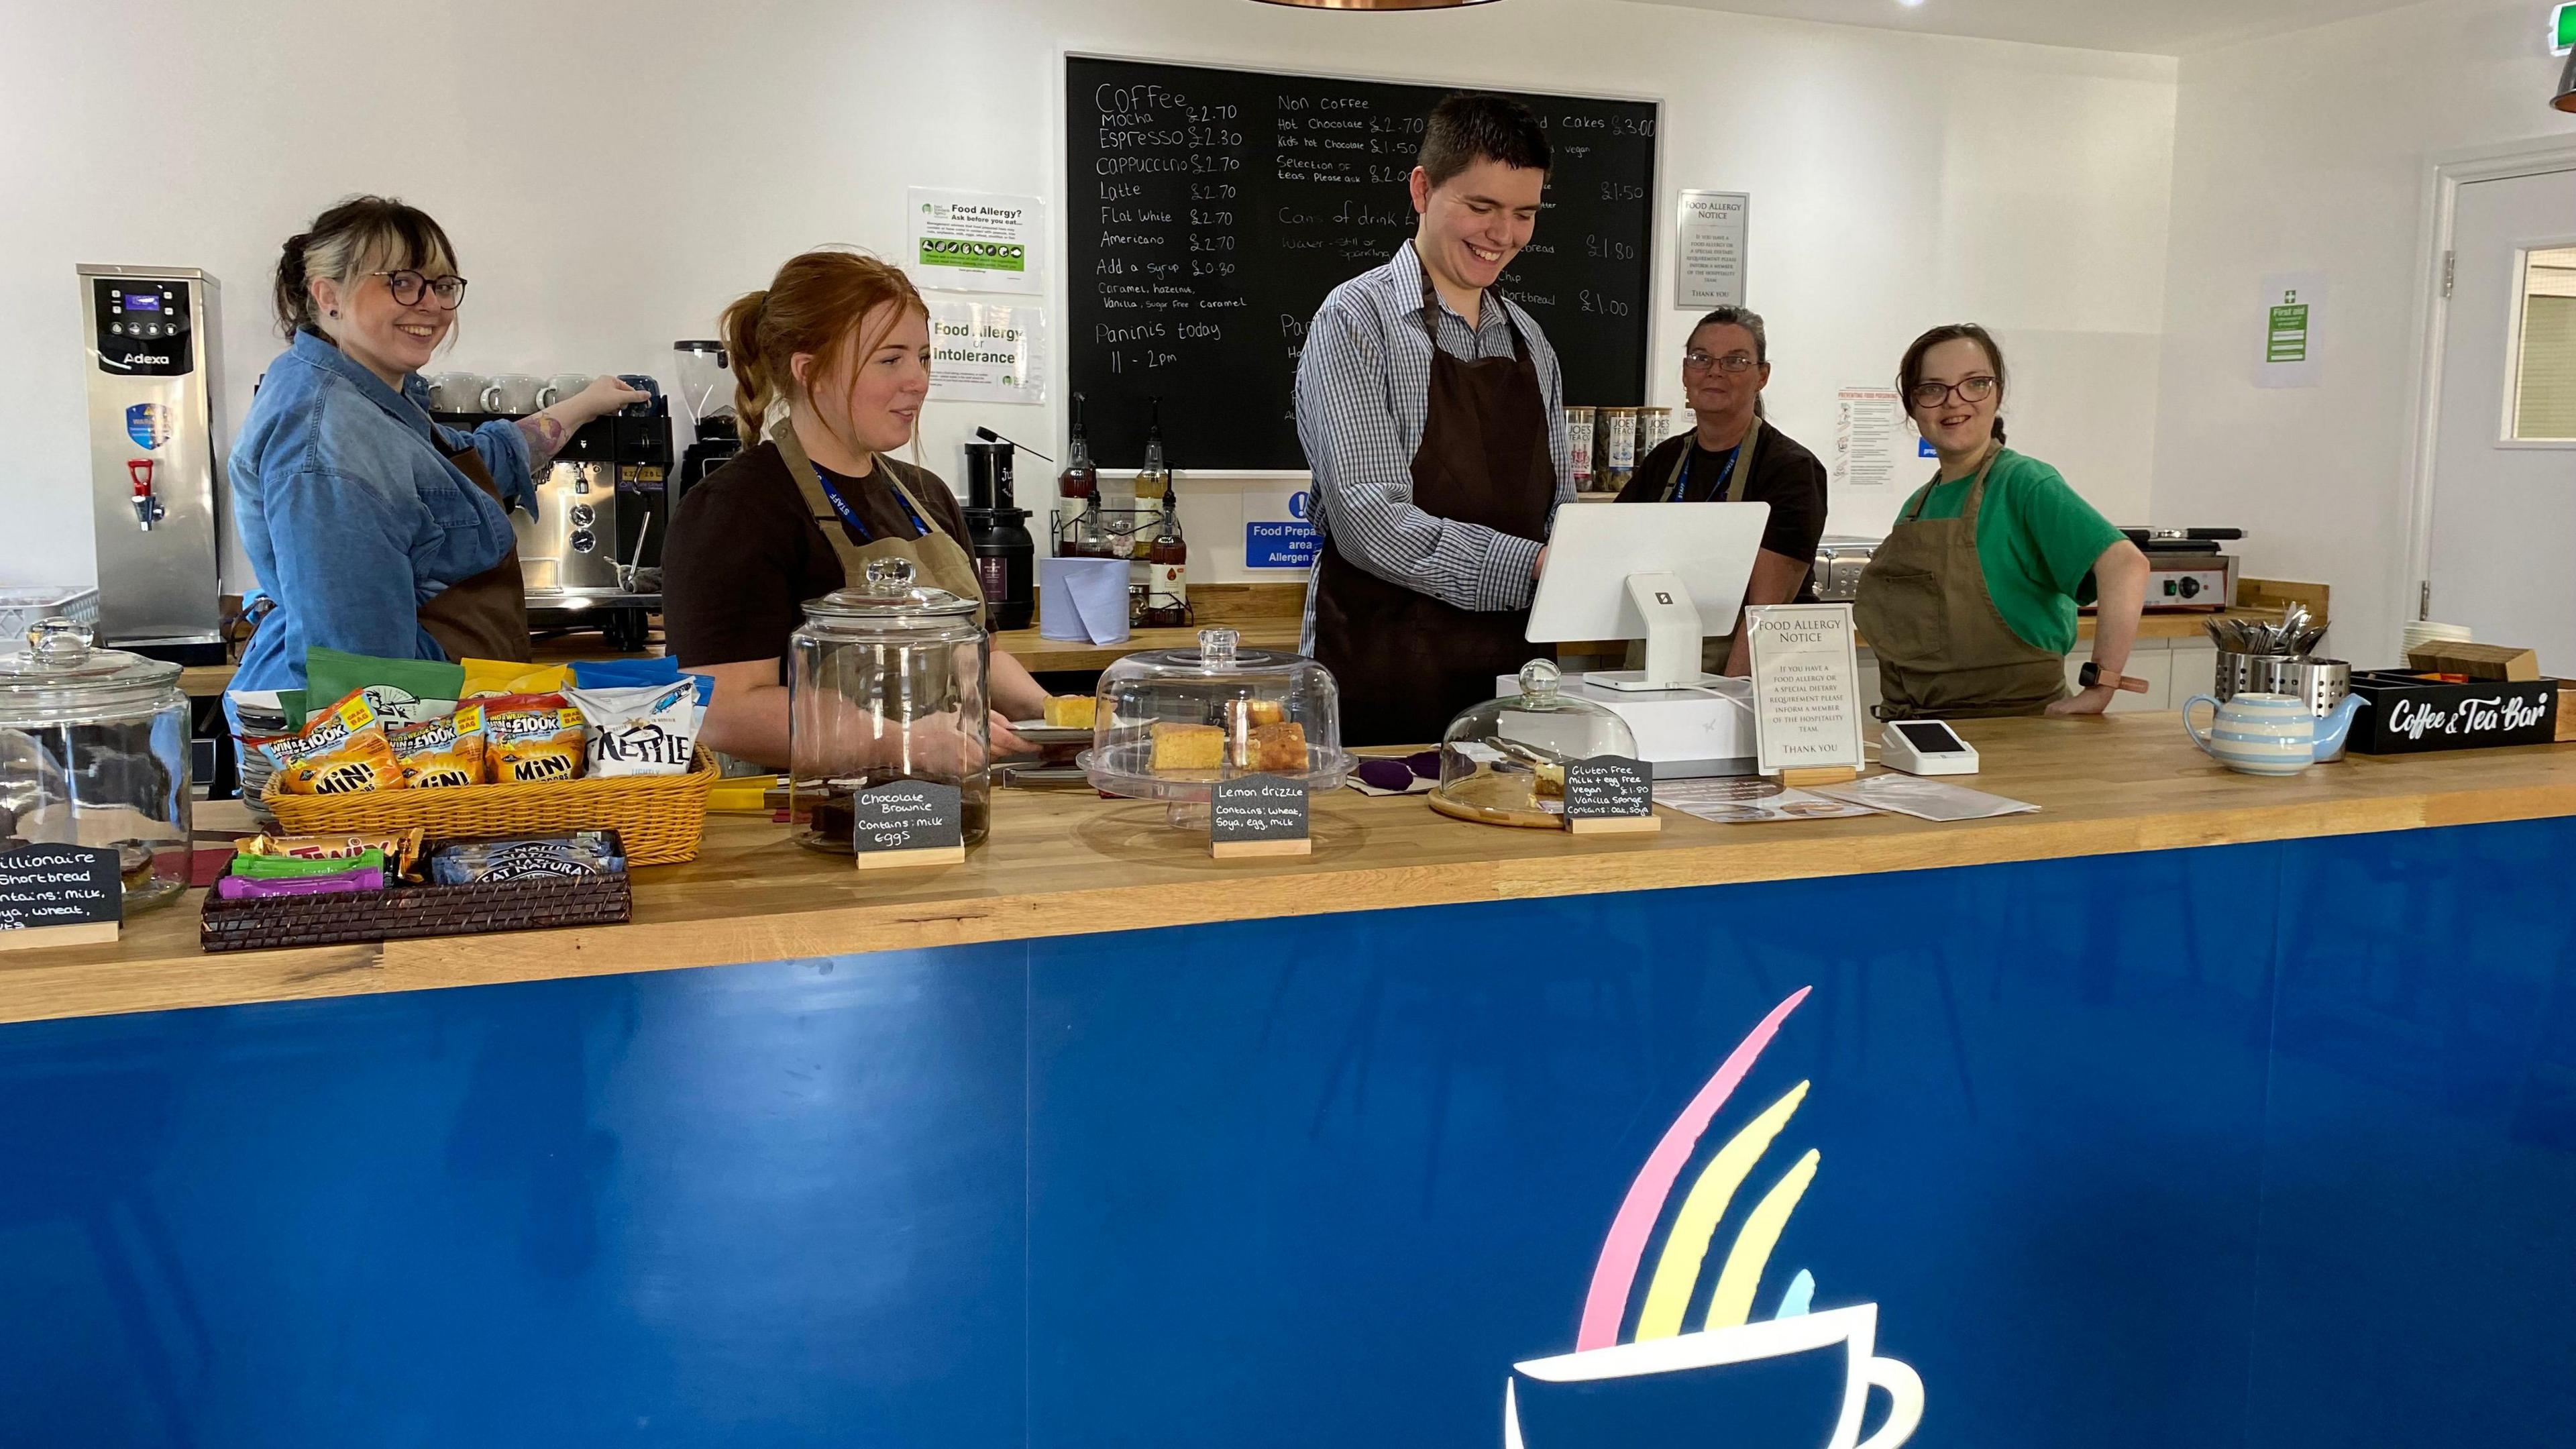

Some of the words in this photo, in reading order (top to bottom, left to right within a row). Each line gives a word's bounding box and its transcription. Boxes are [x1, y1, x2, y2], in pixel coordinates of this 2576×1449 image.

[1278, 95, 1309, 110] Non
[1186, 105, 1237, 123] £2.70
[1278, 119, 1299, 131] Hot
[1308, 118, 1363, 129] Chocolate
[1369, 116, 1424, 133] £2.70
[1562, 116, 1605, 128] Cakes
[1611, 115, 1656, 137] £3.00
[1100, 128, 1183, 150] Espresso
[1188, 126, 1242, 148] £2.30
[1277, 135, 1299, 148] Kids
[1325, 140, 1364, 150] Chocolate
[1370, 139, 1417, 154] £1.50
[1190, 154, 1240, 174] £2.70
[1277, 156, 1334, 169] Selection
[1344, 175, 1360, 183] ask
[1100, 181, 1141, 201] Latte
[1191, 184, 1236, 201] £2.70
[1601, 181, 1643, 201] £1.50
[952, 205, 976, 214] Food
[980, 207, 1022, 219] Allergy?
[1709, 203, 1741, 211] ALLERGY
[1102, 207, 1132, 224] Flat
[1138, 209, 1173, 222] White
[1190, 209, 1232, 225] £2.70
[1358, 205, 1397, 227] drink
[1699, 211, 1727, 219] NOTICE
[1101, 231, 1164, 248] Americano
[1189, 233, 1234, 251] £2.70
[1096, 258, 1123, 275] Add
[1191, 260, 1235, 276] £0.30
[1580, 290, 1628, 316] £1.00
[934, 323, 969, 336] Food
[1095, 321, 1165, 343] Paninis
[1178, 322, 1221, 341] today
[973, 339, 984, 348] or
[124, 353, 169, 365] Adexa
[934, 347, 1015, 364] Intolerance
[1148, 350, 1177, 368] 2pm
[829, 494, 850, 515] STAFF
[1254, 526, 1281, 535] Food
[1285, 526, 1316, 538] Prepa
[1269, 553, 1309, 564] Allergen
[1759, 621, 1790, 631] FOOD
[1794, 620, 1841, 630] ALLERGY
[1780, 633, 1822, 643] NOTICE
[1770, 696, 1819, 704] REQUIREMENT
[347, 709, 365, 720] GRAB
[350, 713, 369, 726] BAG
[2390, 699, 2445, 740] Coffee
[2445, 712, 2459, 734] &
[2459, 696, 2502, 734] Tea
[2501, 692, 2548, 731] Bar
[513, 718, 560, 733] £100K
[271, 741, 292, 755] WIN
[298, 724, 349, 752] £100K
[414, 727, 456, 749] £100K
[594, 724, 690, 765] KETTLE
[1782, 745, 1817, 754] THANK
[1818, 744, 1838, 752] YOU
[1572, 766, 1608, 775] Gluten
[1604, 777, 1620, 787] egg
[861, 794, 924, 805] Chocolate
[1219, 786, 1256, 798] Lemon
[1262, 786, 1303, 797] drizzle
[1575, 796, 1610, 804] Vanilla
[881, 803, 932, 814] Brownie
[1216, 806, 1266, 815] Contains:
[0, 853, 95, 869] illionaire
